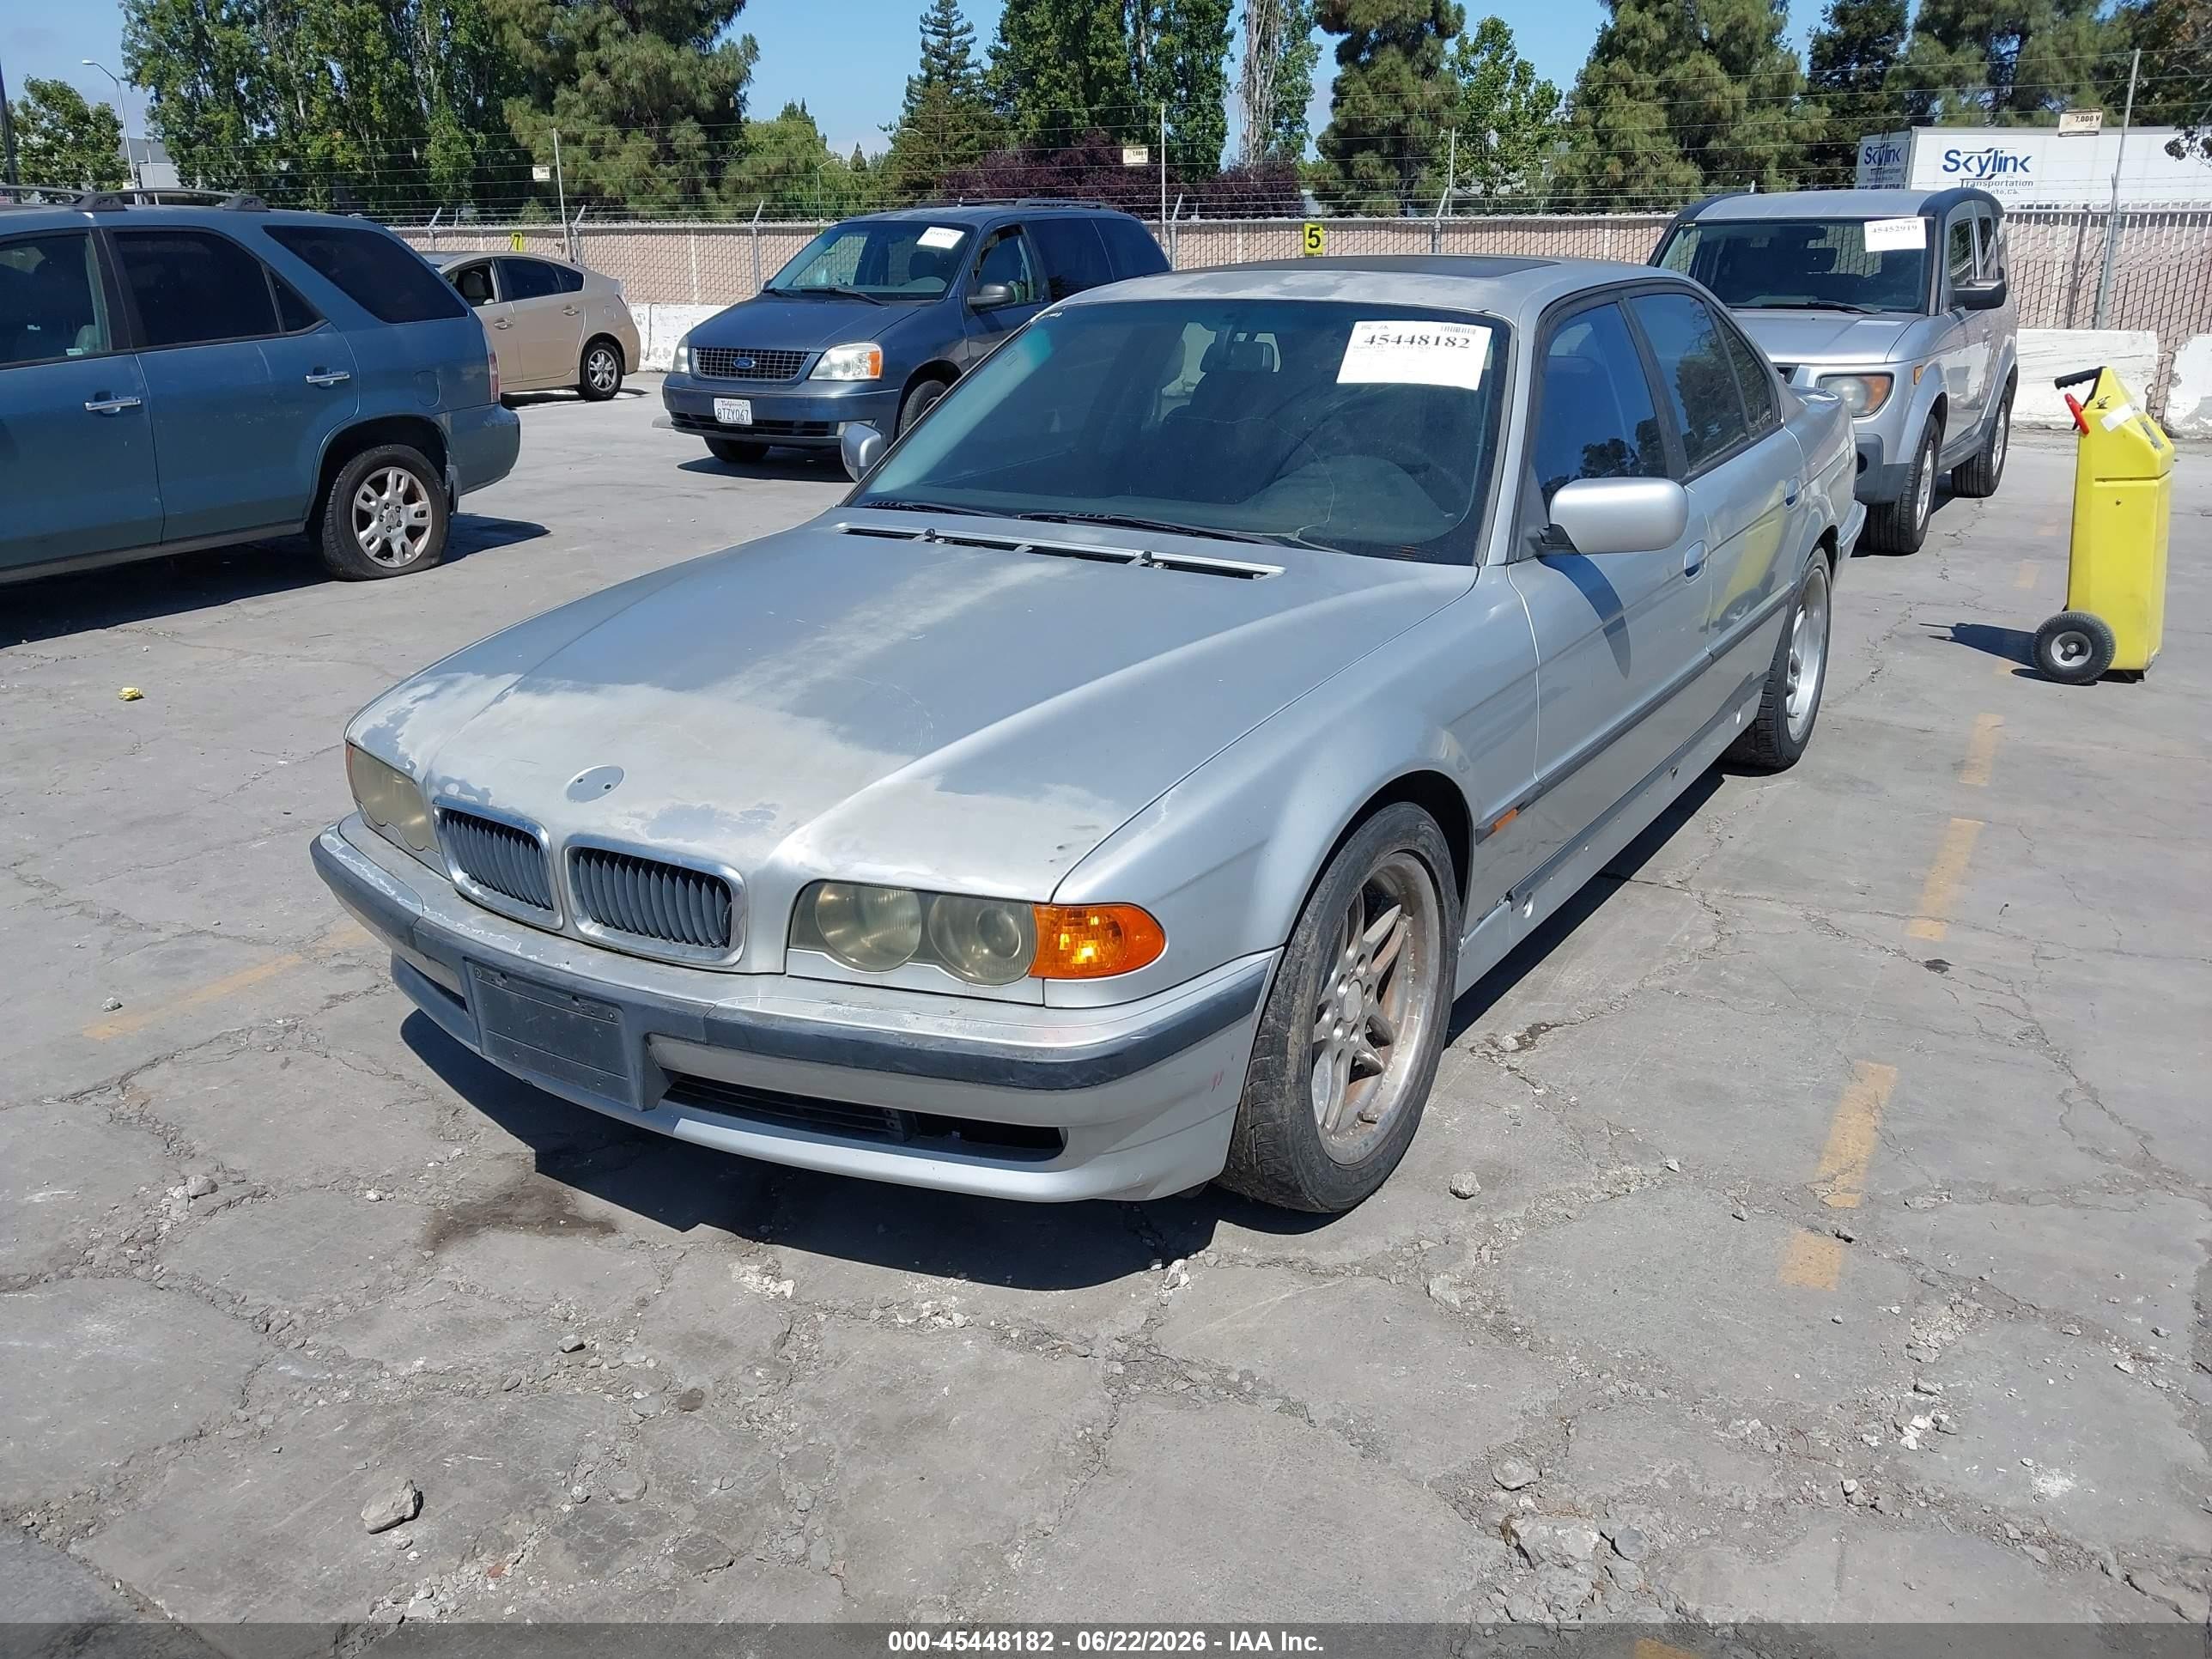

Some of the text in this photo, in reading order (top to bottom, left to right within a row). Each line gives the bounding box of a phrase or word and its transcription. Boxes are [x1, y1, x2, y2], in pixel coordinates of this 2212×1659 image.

[1942, 149, 2033, 178] Skylink
[1960, 178, 2033, 188] Transportation
[513, 234, 520, 250] 7
[1308, 227, 1321, 249] 5
[1364, 334, 1470, 349] 45448182
[717, 407, 749, 422] 8TZY067
